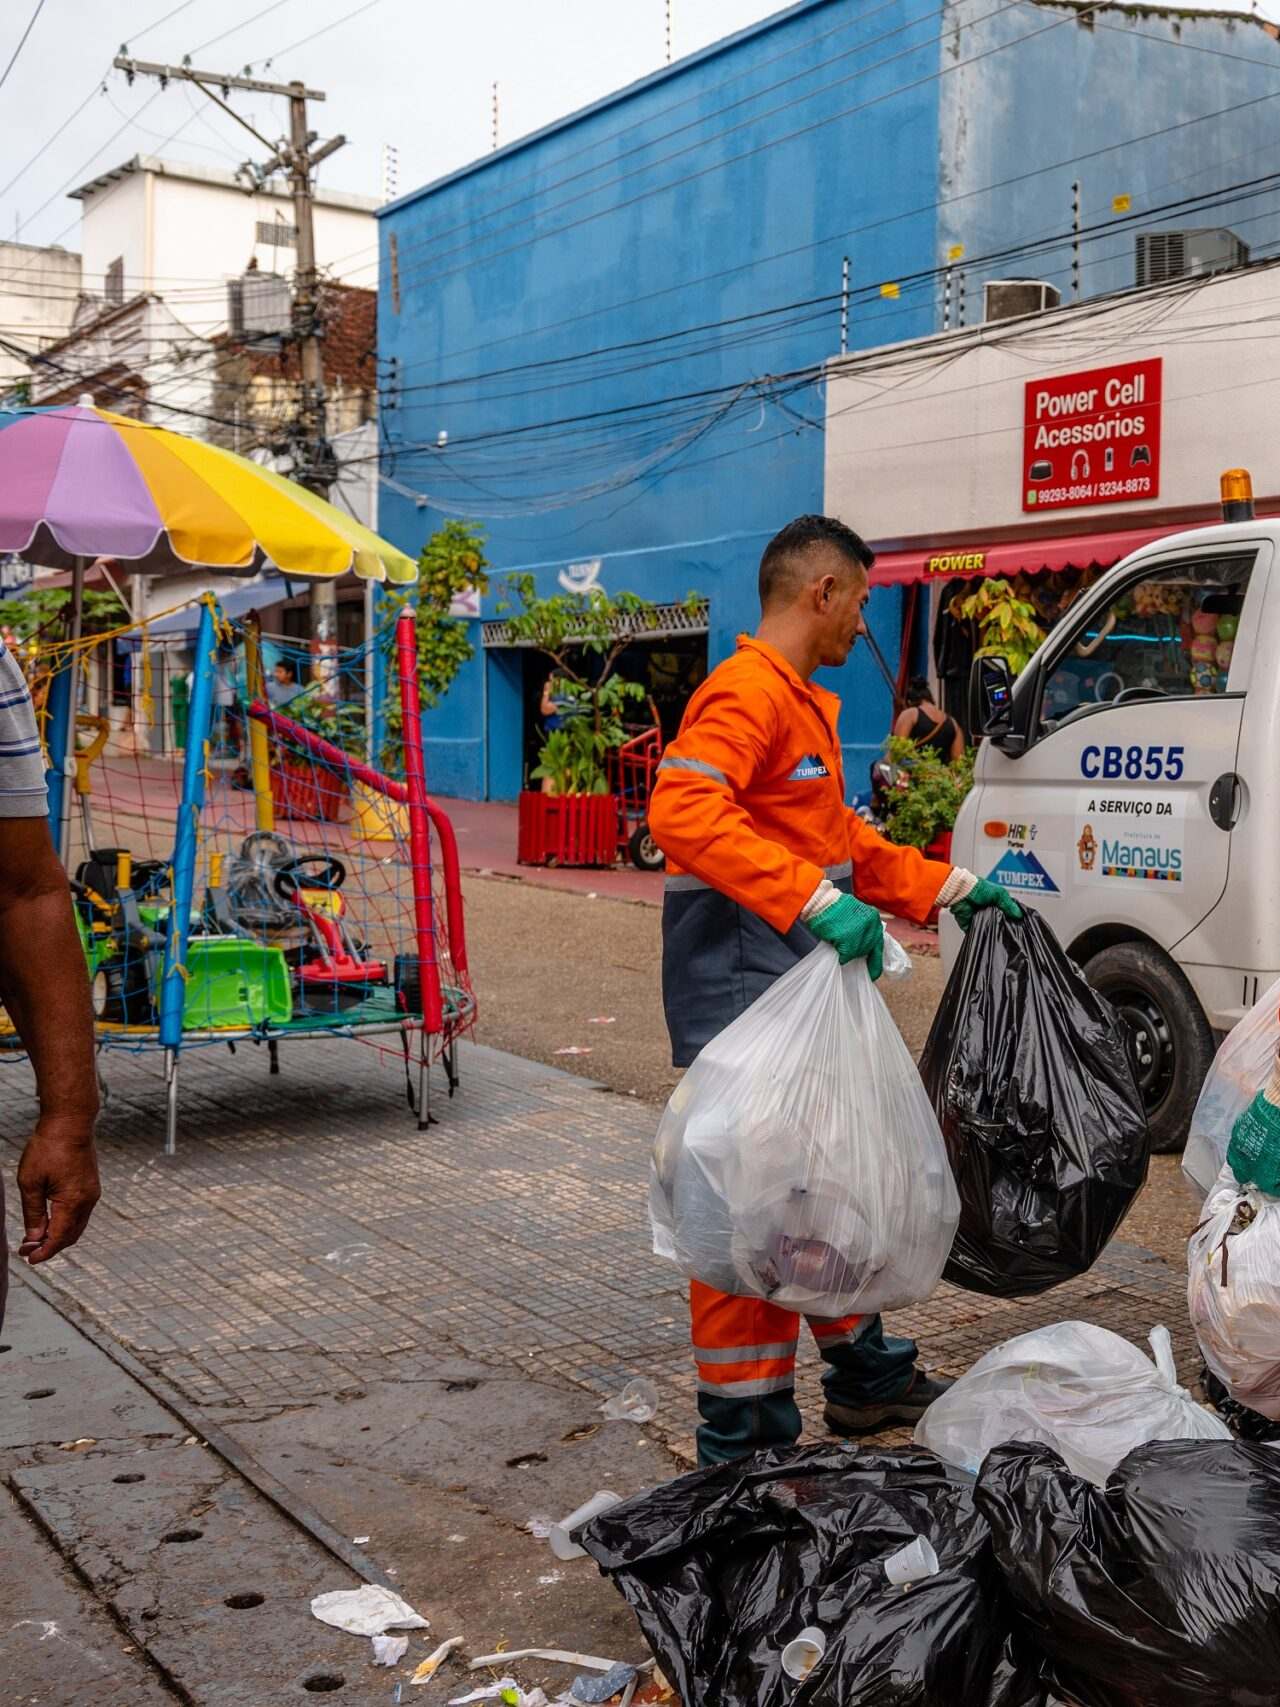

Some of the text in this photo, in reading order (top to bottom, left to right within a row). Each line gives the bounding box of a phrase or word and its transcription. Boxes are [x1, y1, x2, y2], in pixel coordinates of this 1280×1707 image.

[1036, 374, 1145, 419] Power Cell
[1034, 412, 1145, 449] Acessórios
[1099, 477, 1150, 497] 3234-8873
[929, 553, 984, 572] POWER
[796, 765, 827, 777] TUMPEX
[1080, 745, 1184, 781] CB855
[1088, 799, 1172, 817] A SERVIÇO DA
[1102, 840, 1182, 869] Manaus
[996, 870, 1045, 888] TUMPEX
